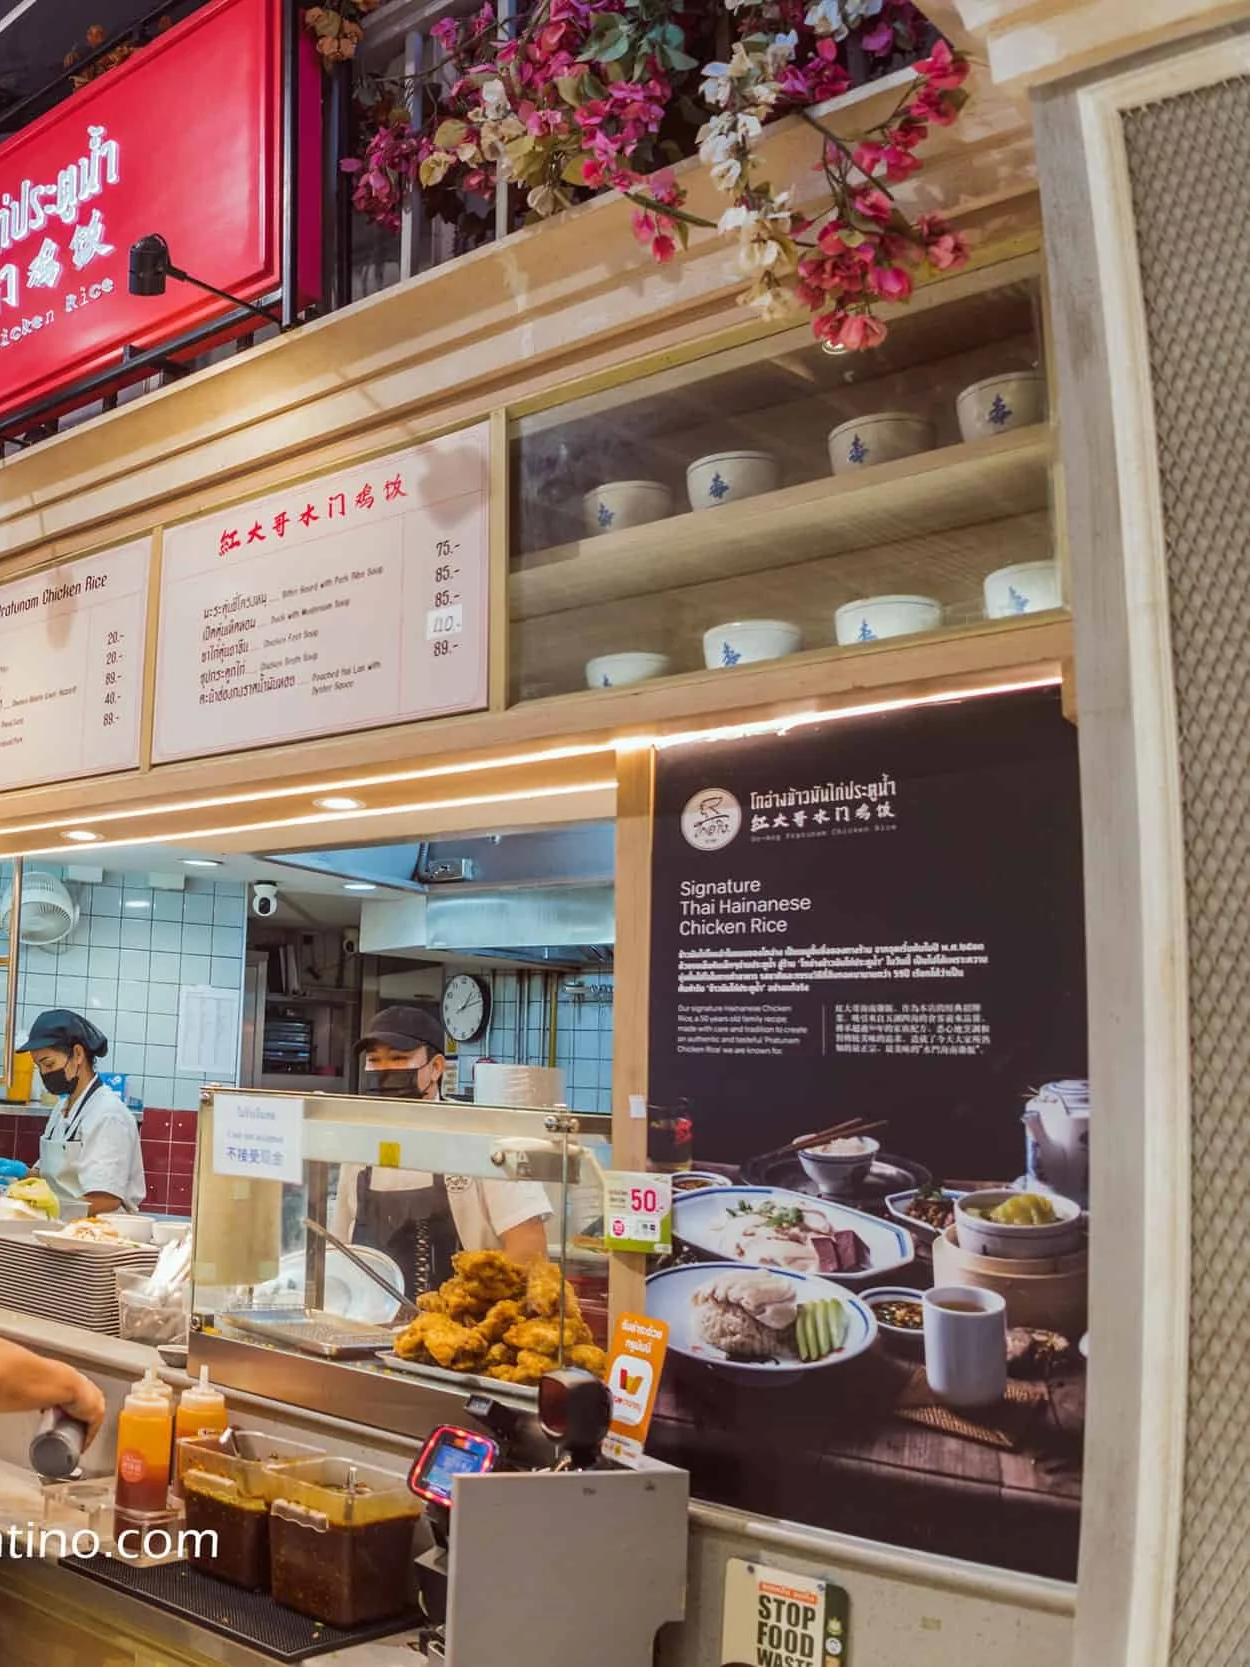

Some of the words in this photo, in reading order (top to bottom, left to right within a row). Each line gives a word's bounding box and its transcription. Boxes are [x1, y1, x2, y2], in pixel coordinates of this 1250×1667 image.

[65, 278, 114, 312] Rice
[435, 540, 461, 557] 75.-
[435, 565, 461, 582] 85.-
[42, 582, 82, 605] Chicken
[85, 574, 107, 591] Rice
[434, 590, 460, 607] 85.-
[433, 639, 459, 657] 89.-
[750, 773, 897, 810] โกอ่างข้าวมันไก่ประตูน้ำ
[679, 878, 761, 899] Signature
[680, 900, 715, 916] Thai
[719, 896, 811, 915] Hainanese
[678, 919, 746, 936] Chicken
[750, 917, 788, 933] Rice
[758, 1594, 816, 1631] STOP
[757, 1621, 815, 1659] FOOD
